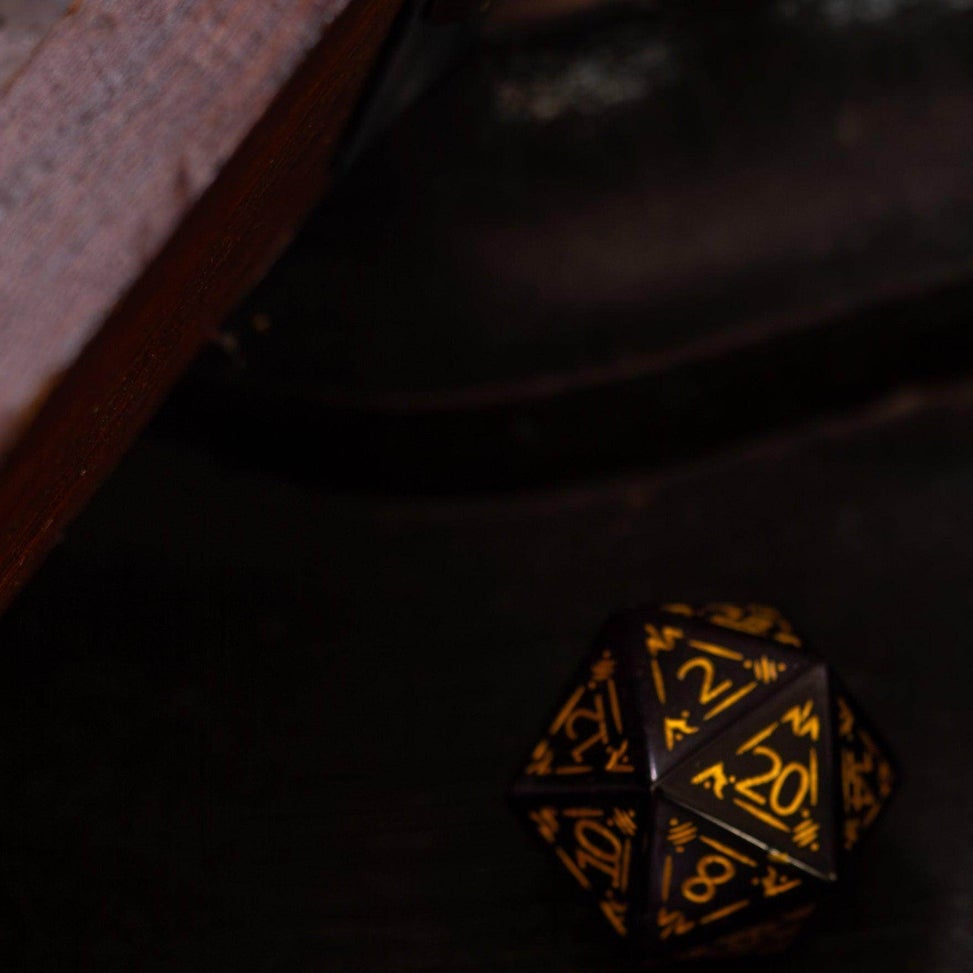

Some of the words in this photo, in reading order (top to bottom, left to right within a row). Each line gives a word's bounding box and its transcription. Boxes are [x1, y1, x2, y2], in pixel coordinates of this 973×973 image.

[676, 657, 734, 706] 2
[565, 693, 608, 765] 12
[733, 744, 809, 816] 20
[574, 819, 624, 890] 10
[681, 854, 736, 904] 8
